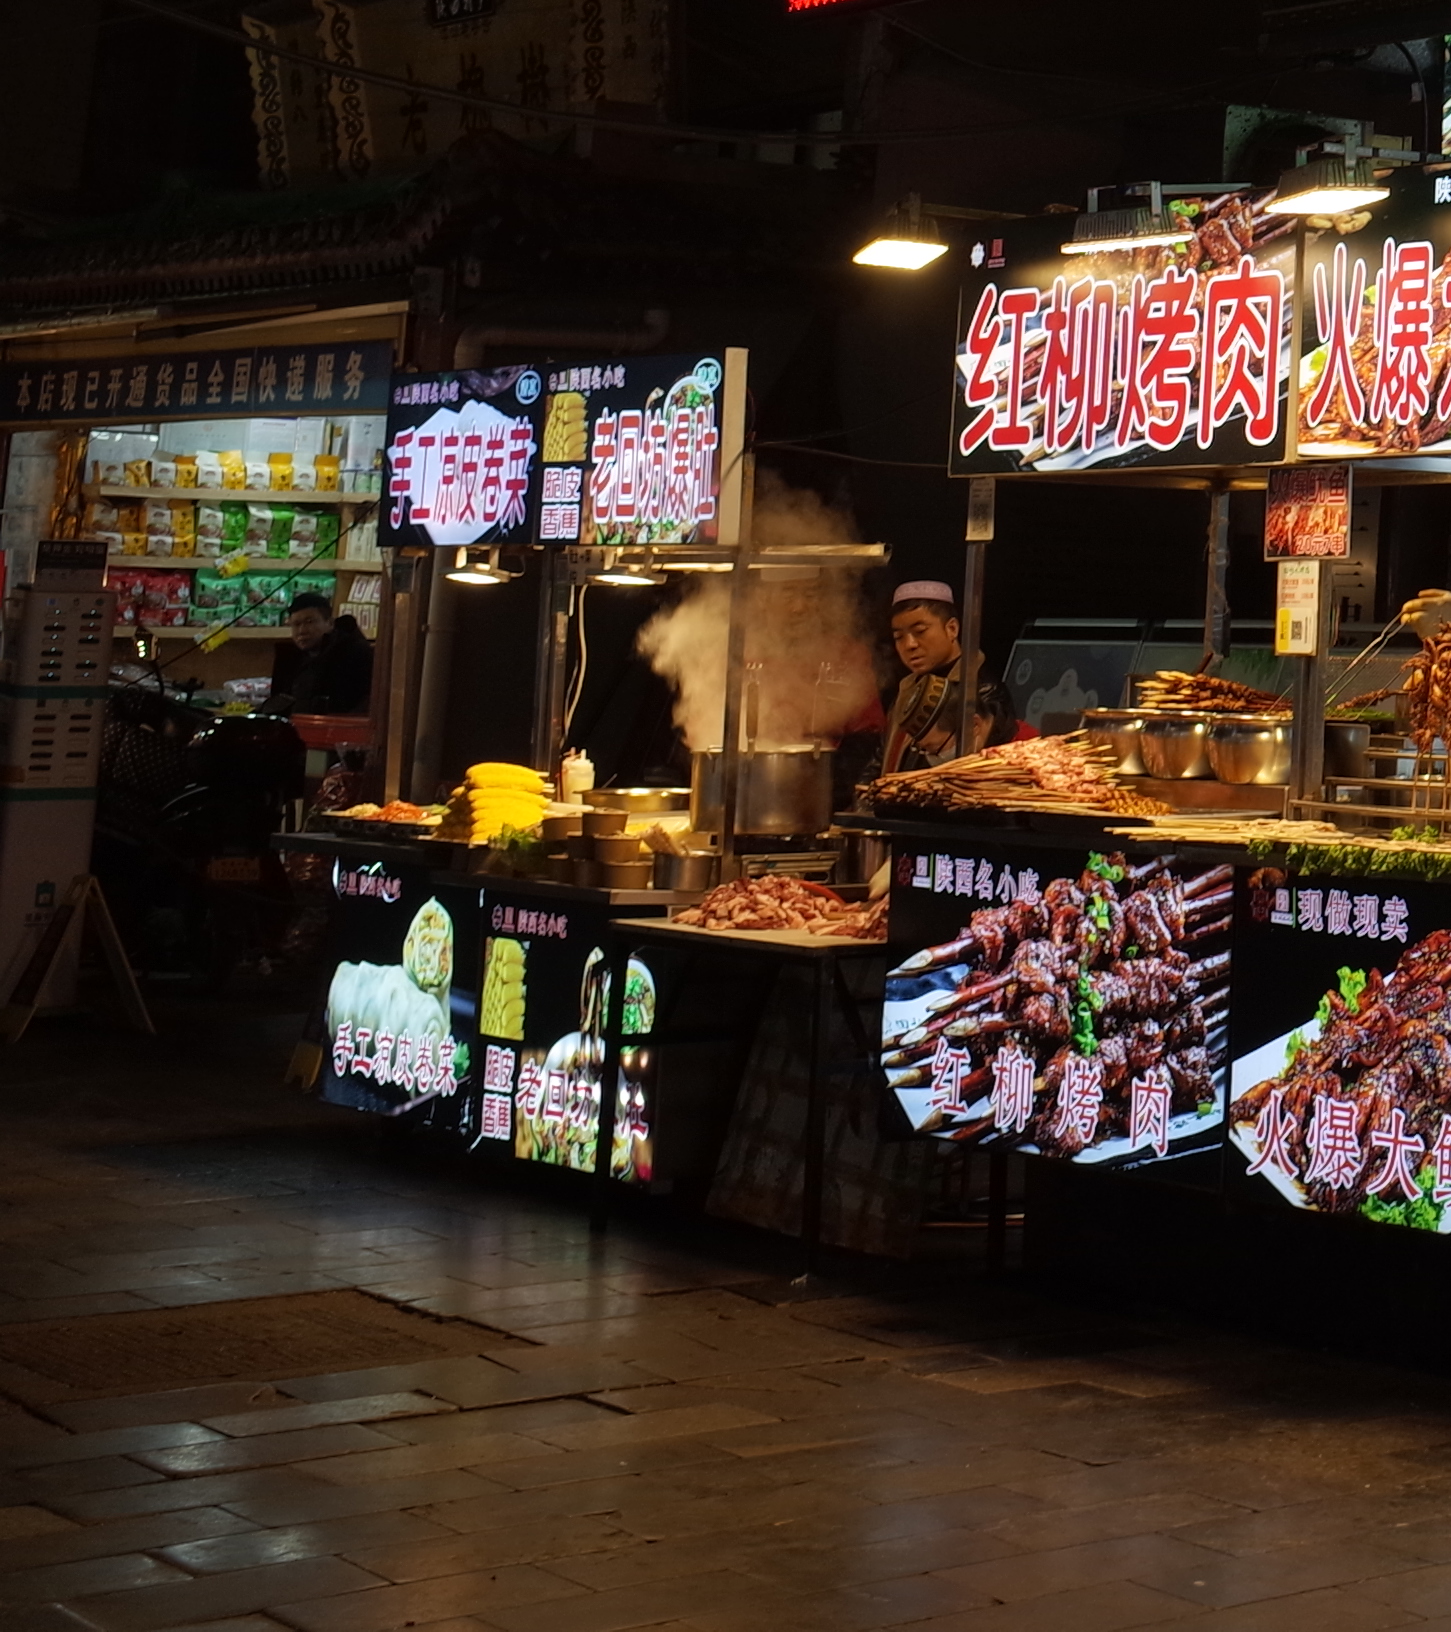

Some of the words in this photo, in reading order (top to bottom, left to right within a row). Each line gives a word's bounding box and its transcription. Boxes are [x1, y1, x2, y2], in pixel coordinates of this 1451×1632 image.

[16, 350, 366, 413] 本店现已开通货品全国快递服务
[958, 254, 1286, 457] 红柳烤肉
[390, 415, 534, 530] 手工凉皮卷菜
[542, 467, 582, 503] 脆皮
[590, 406, 718, 524] 老回坊爆肚
[540, 504, 580, 541] 香蕉
[934, 854, 1042, 906] 陕西名小吃
[1298, 888, 1409, 944] 现做现卖
[333, 1021, 458, 1097] 手工凉皮卷菜
[930, 1036, 1172, 1158] 红柳烤肉
[515, 1058, 649, 1140] 老回坊肚
